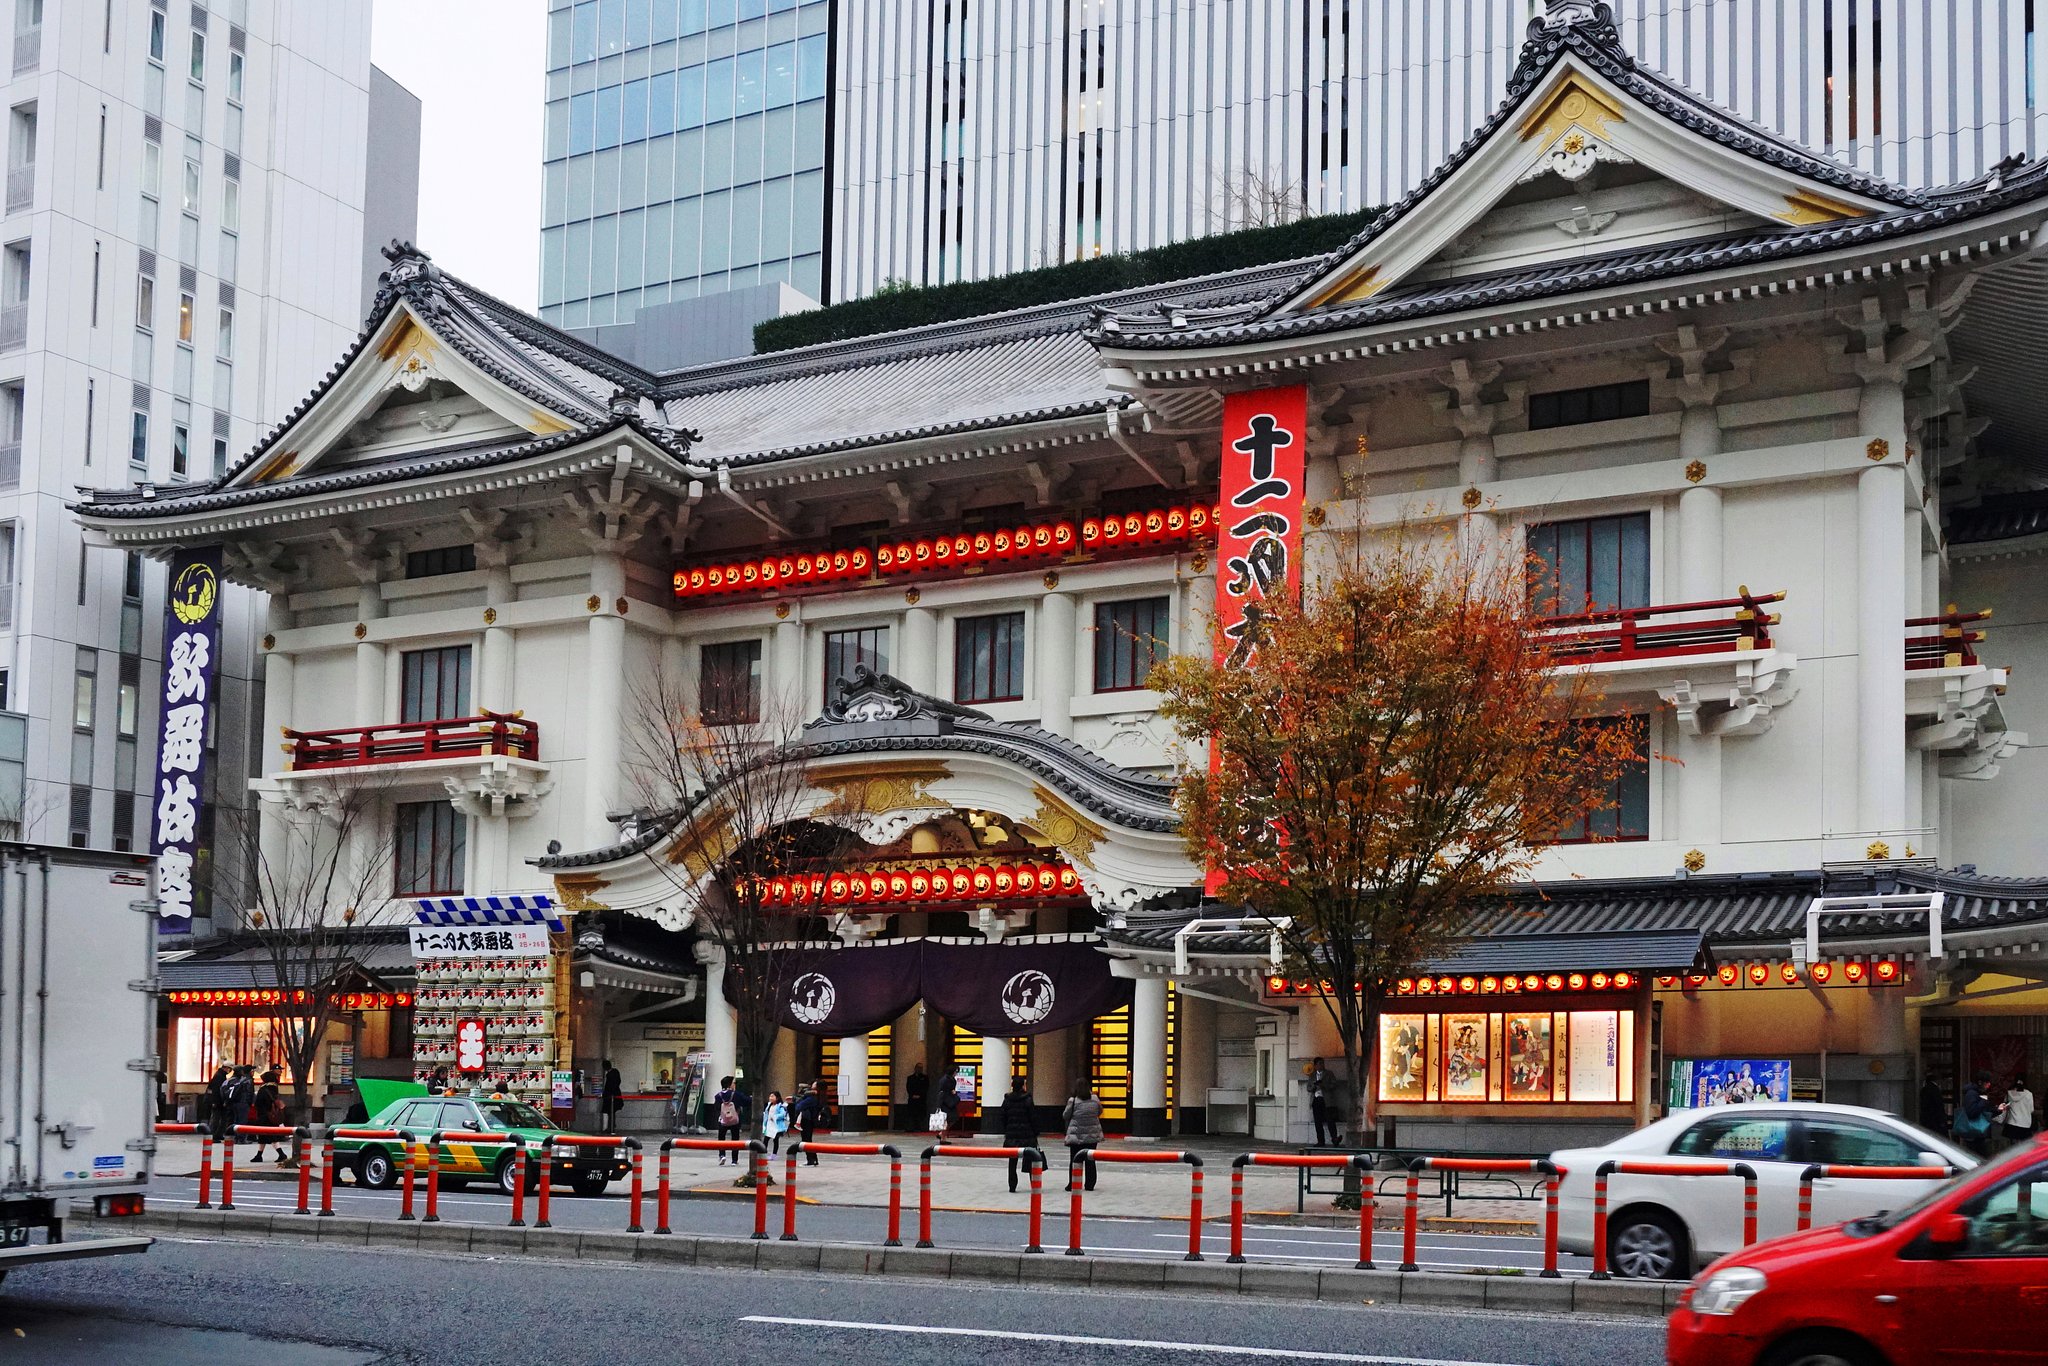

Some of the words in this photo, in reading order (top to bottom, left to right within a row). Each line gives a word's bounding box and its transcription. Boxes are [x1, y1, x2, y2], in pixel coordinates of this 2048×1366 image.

[158, 631, 210, 918] 歌舞伎座
[414, 931, 514, 951] 十二月大歌舞伎
